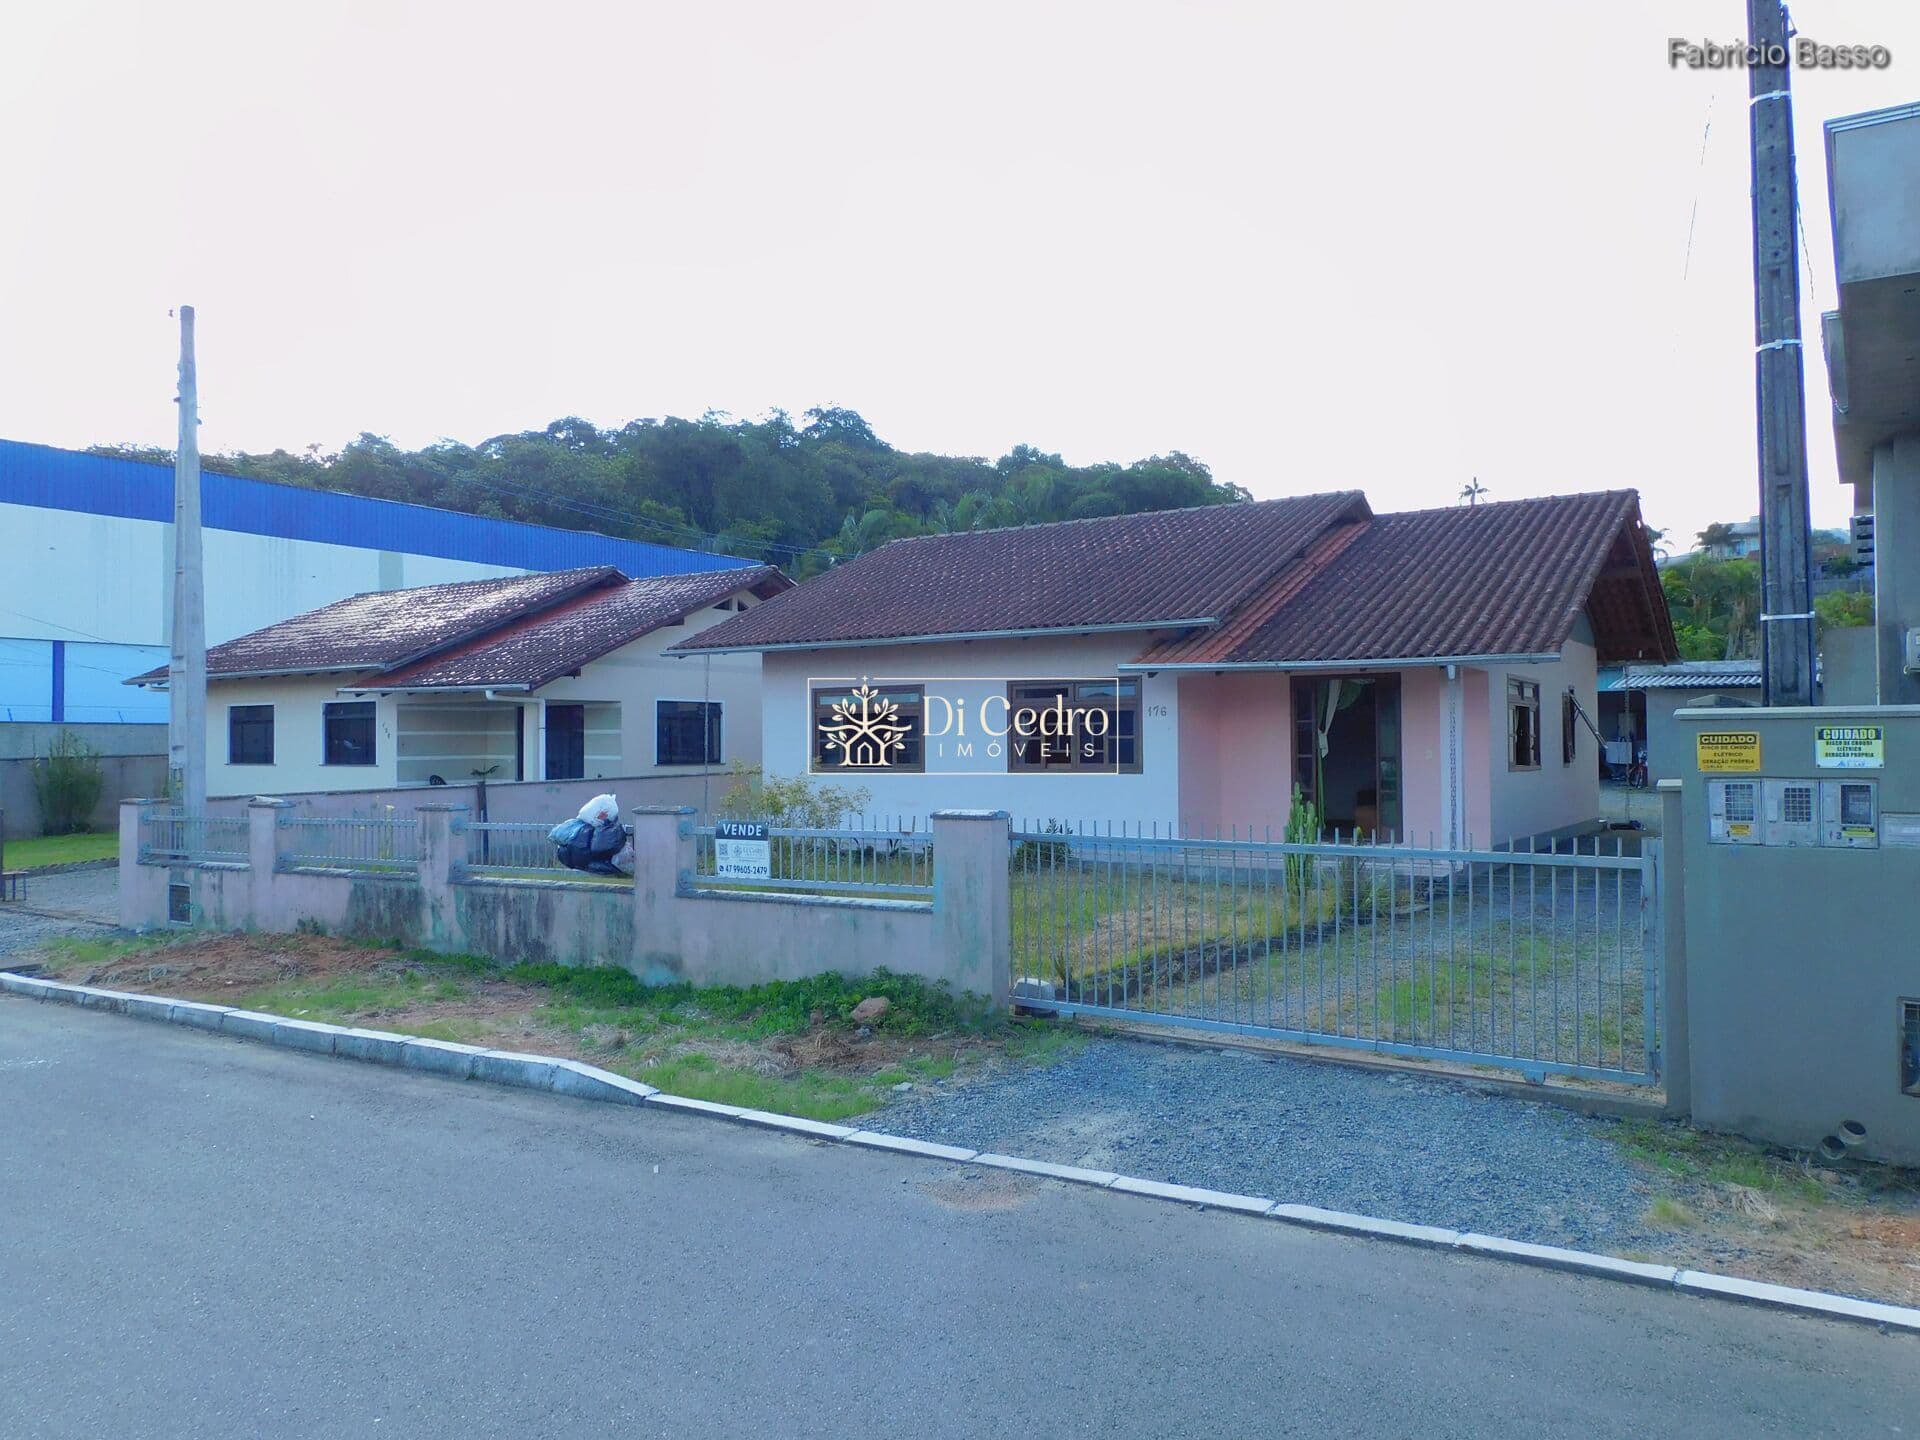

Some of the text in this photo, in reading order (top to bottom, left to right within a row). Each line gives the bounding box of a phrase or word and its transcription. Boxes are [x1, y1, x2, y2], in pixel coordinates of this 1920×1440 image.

[1148, 705, 1167, 717] 176
[1701, 735, 1755, 744] CUIDADO
[1823, 729, 1876, 740] CUIDADO
[722, 823, 762, 837] VENDE
